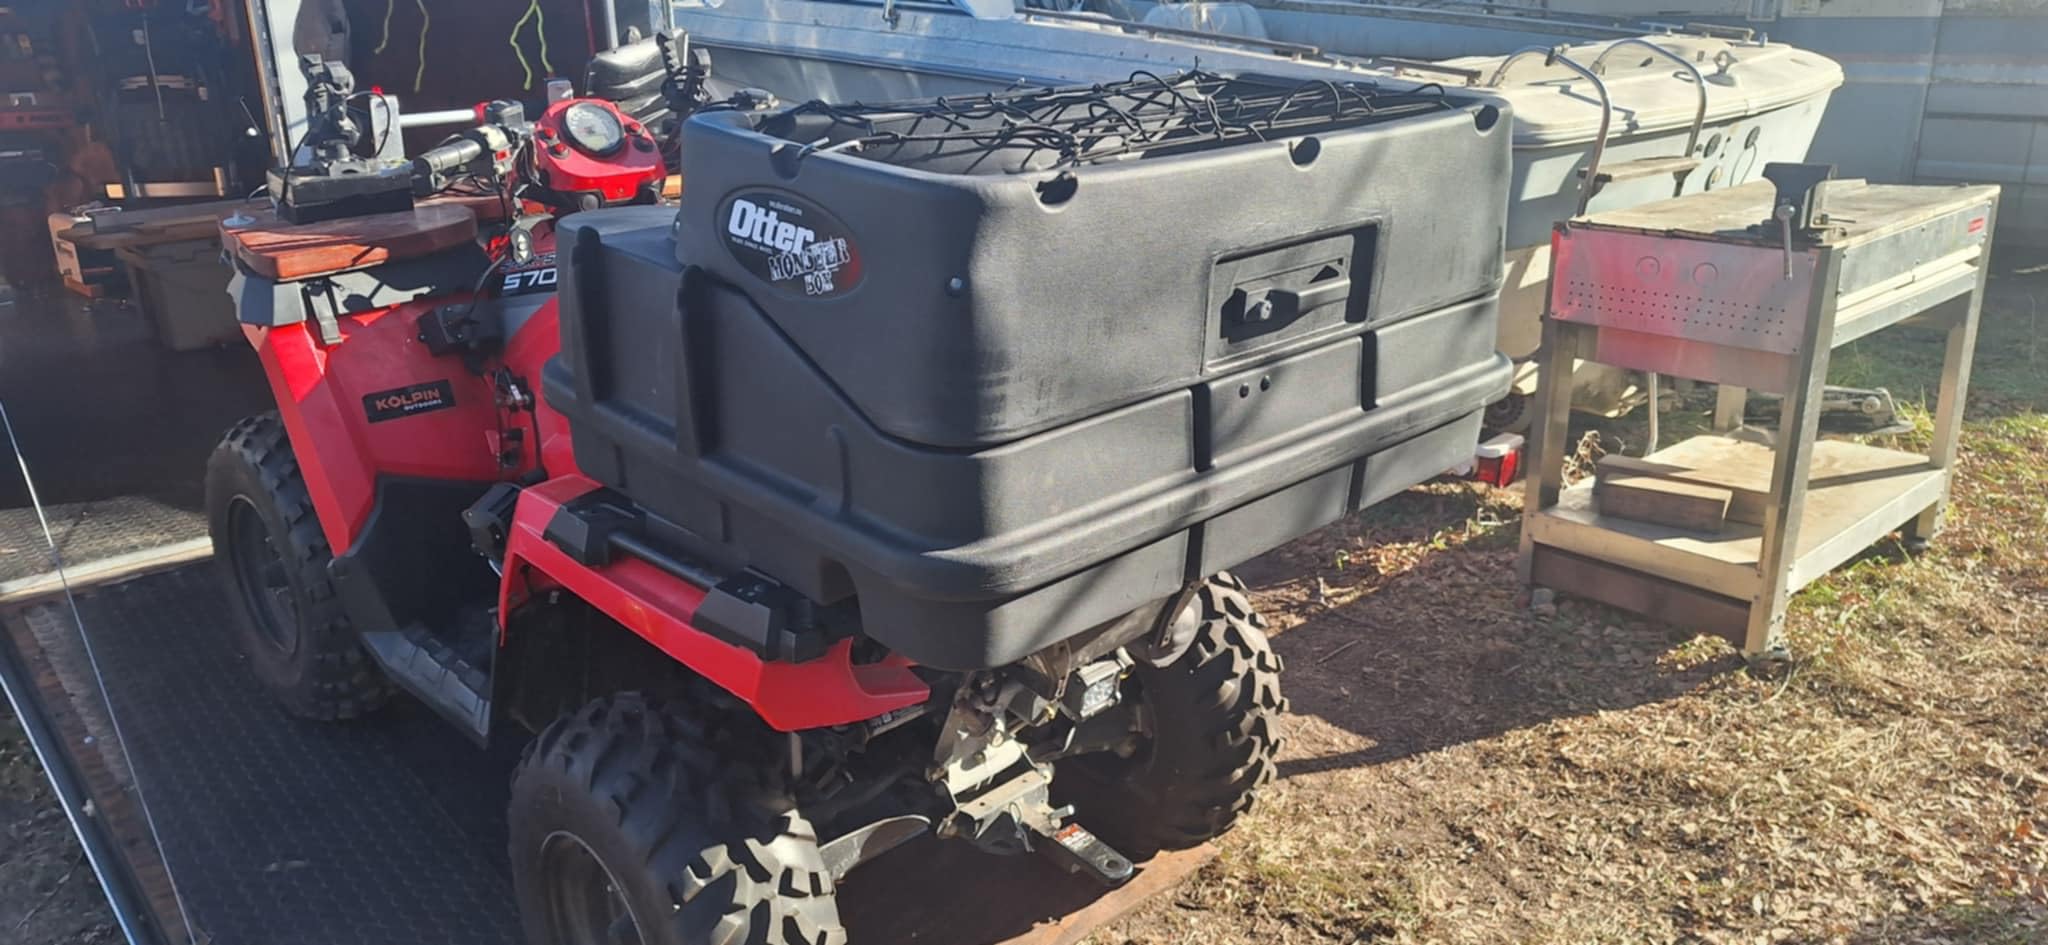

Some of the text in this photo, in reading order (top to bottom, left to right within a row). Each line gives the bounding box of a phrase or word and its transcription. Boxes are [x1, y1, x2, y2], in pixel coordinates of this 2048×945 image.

[728, 199, 816, 254] Otter
[804, 271, 834, 295] BOX
[376, 389, 440, 411] KOLPIN
[403, 399, 442, 411] OUTDOORS
